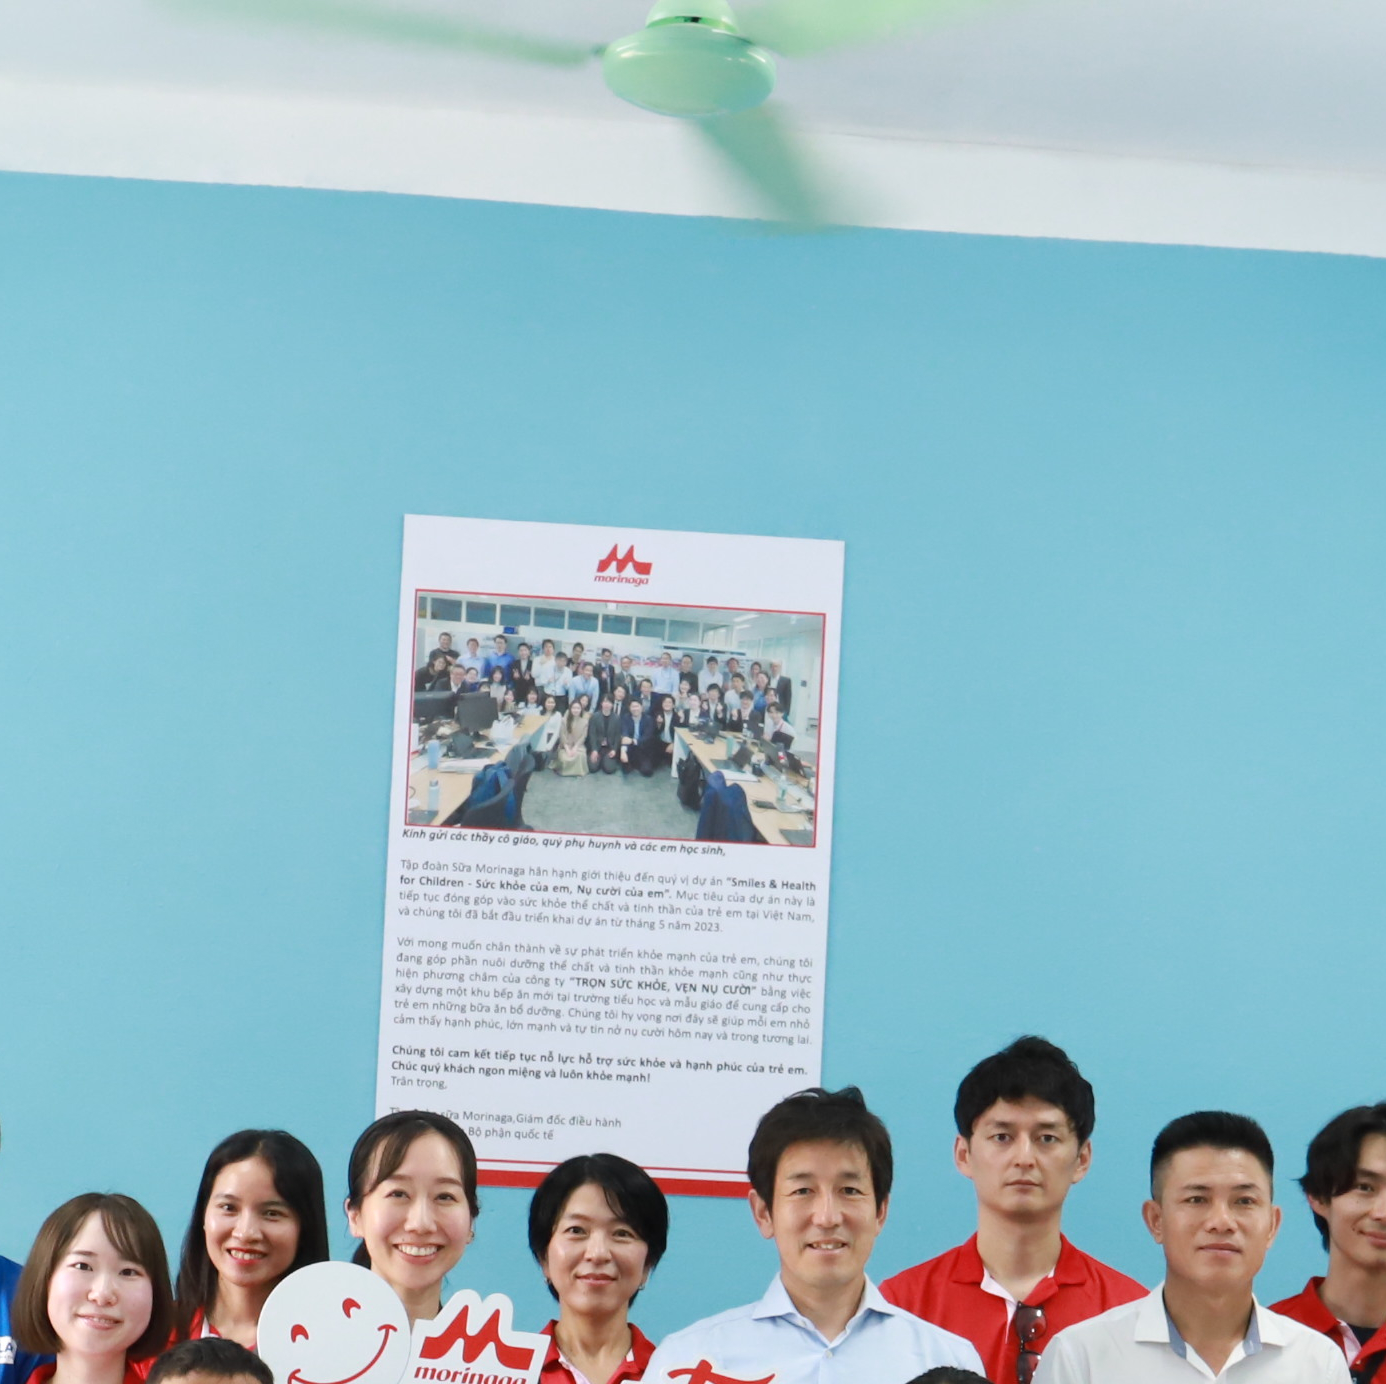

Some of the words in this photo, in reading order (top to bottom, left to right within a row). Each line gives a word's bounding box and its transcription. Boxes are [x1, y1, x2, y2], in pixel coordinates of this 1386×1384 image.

[594, 574, 649, 587] morinaga
[402, 828, 426, 838] Kính
[428, 830, 447, 842] gửi
[450, 833, 467, 841] các
[470, 833, 494, 844] thầy
[497, 834, 509, 843] cô
[542, 838, 562, 848] quý
[564, 838, 584, 849] phụ
[587, 839, 621, 851] huynh
[624, 842, 636, 850] và
[640, 843, 656, 851] các
[679, 845, 698, 855] học
[400, 859, 418, 871] Tập
[422, 860, 448, 871] đoàn
[452, 862, 471, 872] Sữa
[475, 863, 525, 877] Morinaga
[551, 868, 577, 879] hạnh
[581, 870, 600, 881] giới
[604, 870, 630, 882] thiệu
[634, 871, 654, 882] đến
[657, 873, 676, 885] quý
[680, 875, 688, 885] vị
[692, 875, 706, 886] dự
[710, 876, 722, 885] án
[768, 879, 777, 889] &
[781, 880, 816, 890] Health
[399, 874, 415, 884] for
[419, 875, 463, 887] Children
[475, 879, 495, 889] Sức
[499, 879, 526, 890] khỏe
[529, 881, 548, 892] của
[552, 885, 572, 894] em,
[577, 884, 591, 896] Nụ
[595, 885, 621, 896] cười
[624, 886, 643, 897] của
[676, 890, 698, 900] Mục
[703, 891, 723, 901] tiêu
[727, 892, 745, 902] của
[749, 894, 763, 904] dự
[768, 895, 780, 904] án
[784, 896, 802, 906] này
[806, 897, 815, 906] là
[398, 906, 409, 915] và
[412, 906, 445, 919] chúng
[448, 908, 461, 918] tôi
[465, 909, 478, 919] đã
[481, 908, 498, 920] bắt
[501, 910, 521, 921] đầu
[524, 911, 549, 922] triển
[552, 914, 574, 924] khai
[577, 915, 591, 926] dự
[595, 917, 607, 926] án
[610, 918, 622, 926] từ
[625, 918, 655, 930] tháng
[659, 919, 665, 929] 5
[668, 920, 690, 930] năm
[694, 921, 722, 932] 2023.
[395, 967, 418, 979] hiện
[423, 969, 464, 982] phương
[469, 971, 497, 982] châm
[502, 972, 520, 983] của
[525, 974, 550, 986] công
[554, 977, 564, 987] ty
[610, 977, 632, 989] SỨC
[637, 978, 670, 992] KHỎE,
[674, 982, 697, 993] VẸN
[701, 983, 718, 994] NỤ
[761, 985, 786, 998] bằng
[790, 988, 810, 999] việc
[391, 1060, 417, 1071] Chúc
[420, 1062, 440, 1074] quý
[443, 1062, 475, 1074] khách
[478, 1067, 505, 1077] ngon
[507, 1066, 541, 1079] miệng
[544, 1068, 556, 1078] và
[559, 1068, 583, 1079] luôn
[586, 1069, 612, 1081] khỏe
[615, 1071, 650, 1084] mạnh!
[392, 1044, 426, 1058] Chúng
[429, 1046, 444, 1056] tôi
[447, 1049, 470, 1058] cam
[474, 1048, 490, 1059] kết
[494, 1049, 516, 1062] tiếp
[519, 1052, 536, 1063] tục
[557, 1053, 574, 1065] lực
[596, 1056, 613, 1067] trợ
[616, 1056, 636, 1066] sức
[639, 1056, 666, 1068] khỏe
[669, 1058, 681, 1068] và
[685, 1059, 712, 1072] hạnh
[716, 1061, 742, 1073] phúc
[746, 1061, 765, 1072] của
[768, 1063, 784, 1074] trẻ
[787, 1067, 807, 1075] em.
[390, 1076, 413, 1086] Trân
